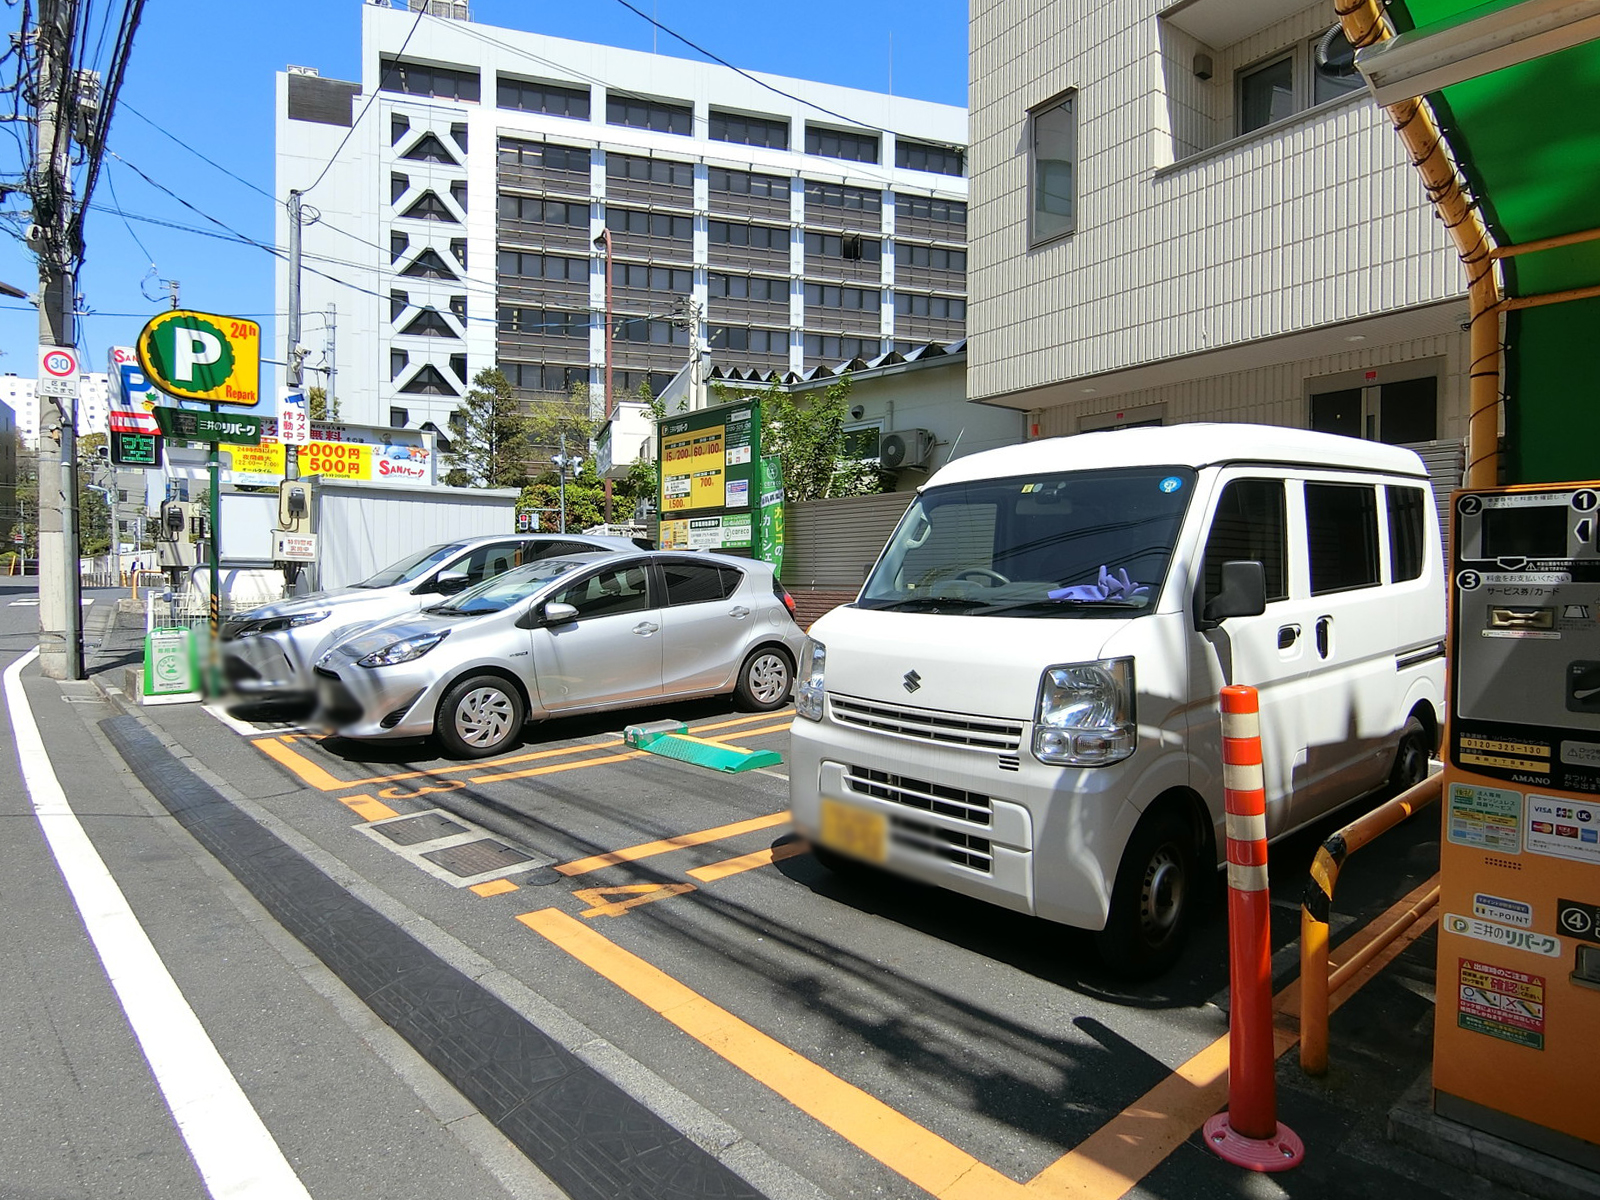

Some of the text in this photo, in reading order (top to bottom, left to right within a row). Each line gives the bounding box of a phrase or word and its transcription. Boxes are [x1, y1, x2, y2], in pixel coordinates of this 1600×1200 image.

[174, 326, 222, 382] P
[51, 357, 69, 370] 30
[120, 364, 154, 405] P
[225, 384, 255, 401] Repark
[200, 420, 256, 436] 三井のリパーク
[282, 410, 294, 441] 作動中
[297, 412, 306, 442] カメラ
[309, 458, 360, 475] 500円
[379, 460, 425, 478] SANパーク
[1465, 498, 1477, 513] 2
[1578, 493, 1588, 509] 1
[774, 506, 784, 556] カレコの
[1464, 573, 1476, 588] 3
[1487, 586, 1560, 597] サービス券/カード
[1467, 739, 1542, 755] 0120-325-130
[1511, 774, 1551, 786] AMANO
[1534, 806, 1552, 814] VISA
[1489, 909, 1530, 924] T-POINT
[1567, 912, 1584, 929] 4
[1473, 922, 1555, 954] 三井のリパーク
